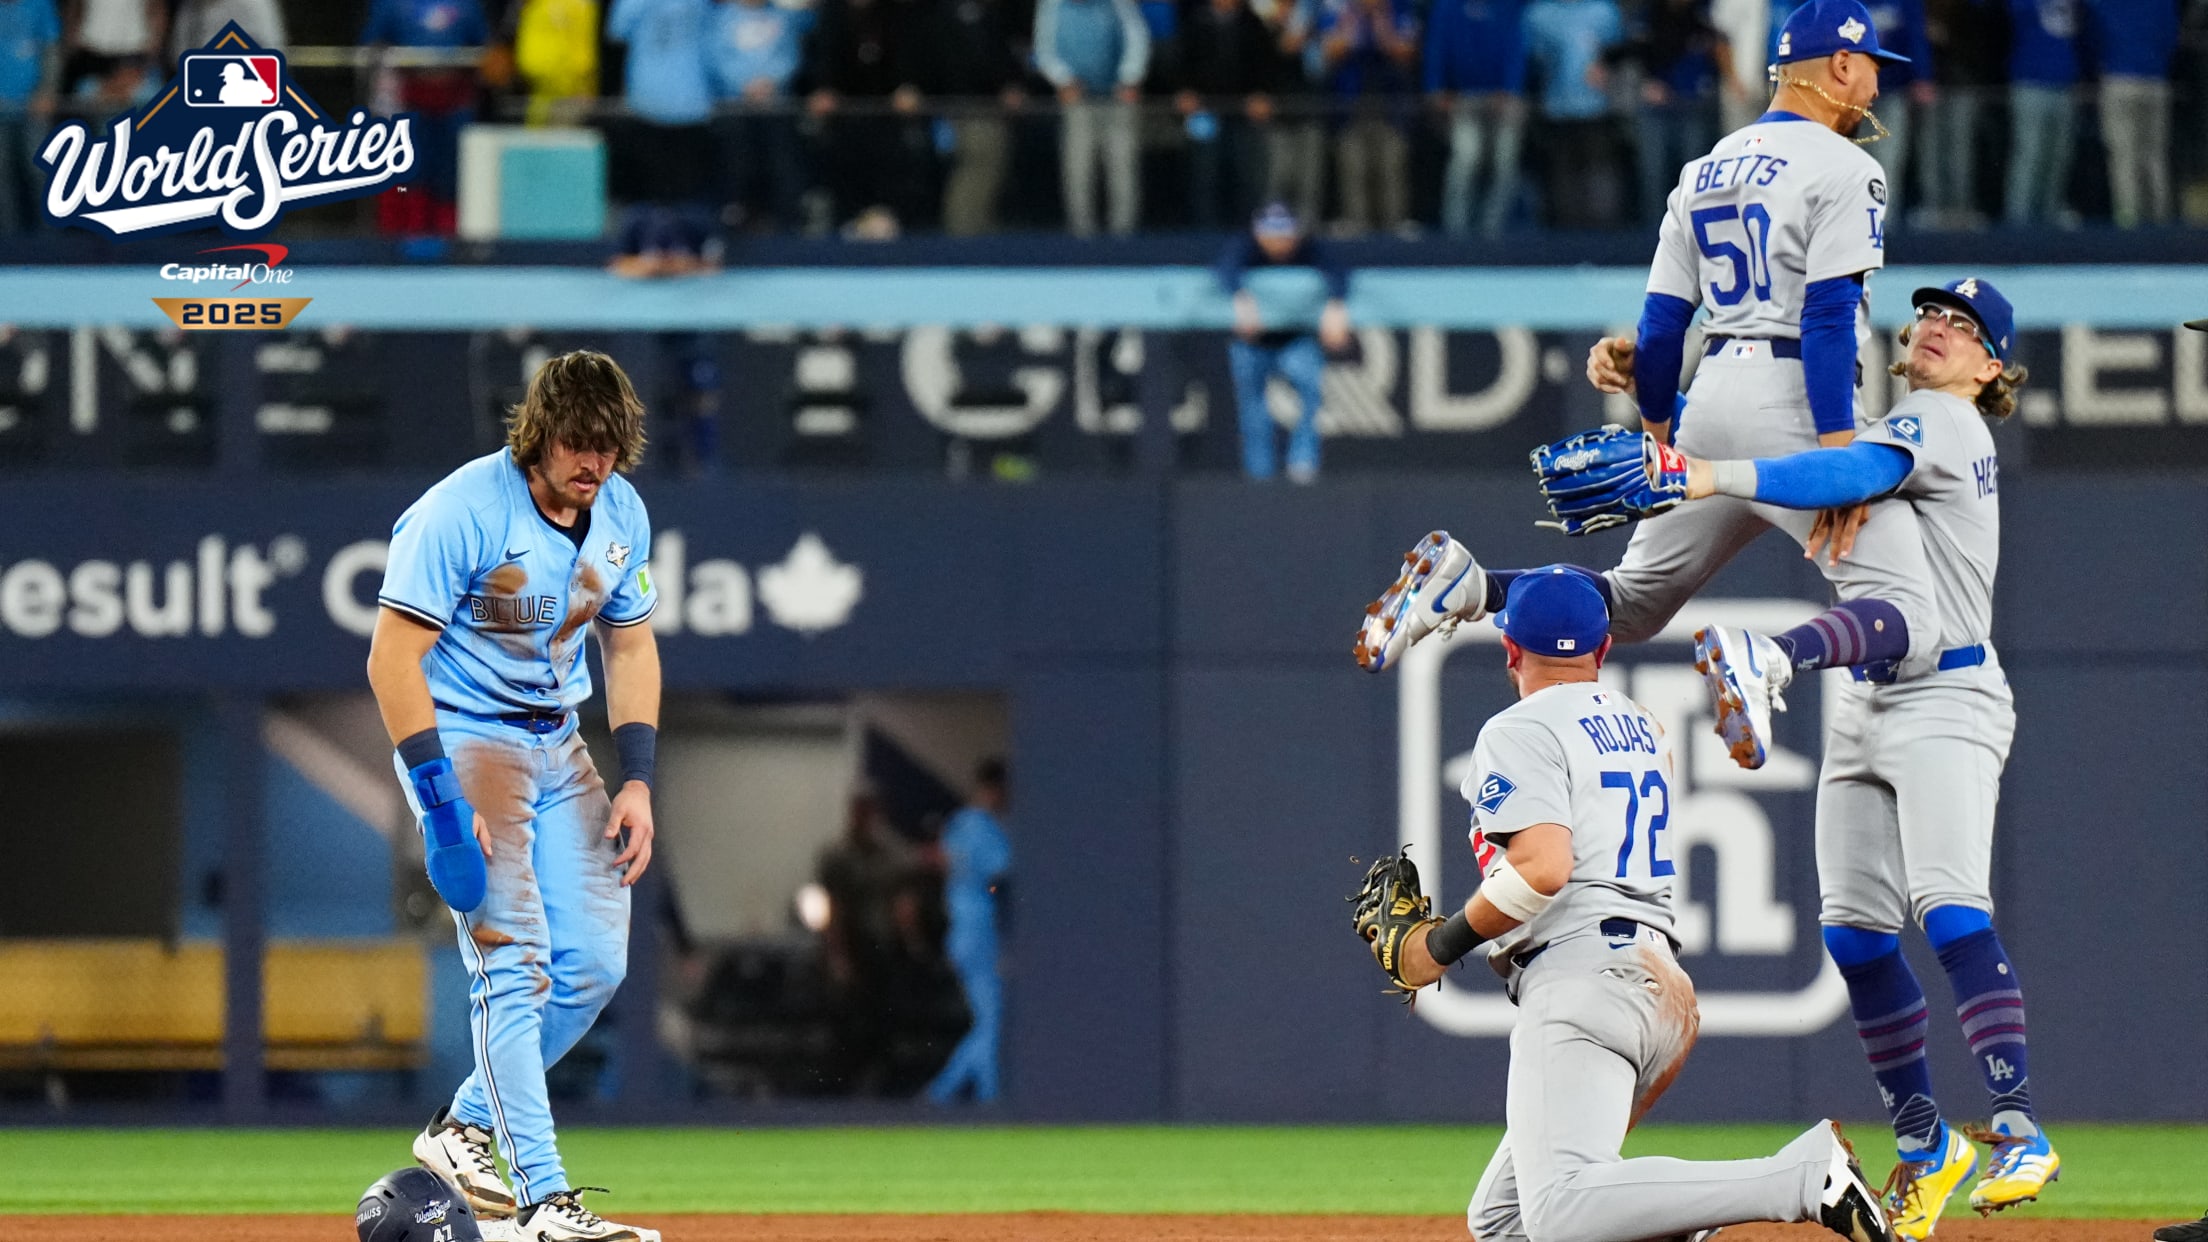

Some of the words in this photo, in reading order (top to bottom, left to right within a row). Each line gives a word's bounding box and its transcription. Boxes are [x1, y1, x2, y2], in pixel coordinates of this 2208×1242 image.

[1694, 153, 1789, 194] BETTS
[1690, 202, 1772, 307] 50
[469, 595, 557, 625] BLUE
[1578, 713, 1657, 755] ROJAS
[1600, 769, 1677, 878] 72
[1985, 1054, 2014, 1082] LA
